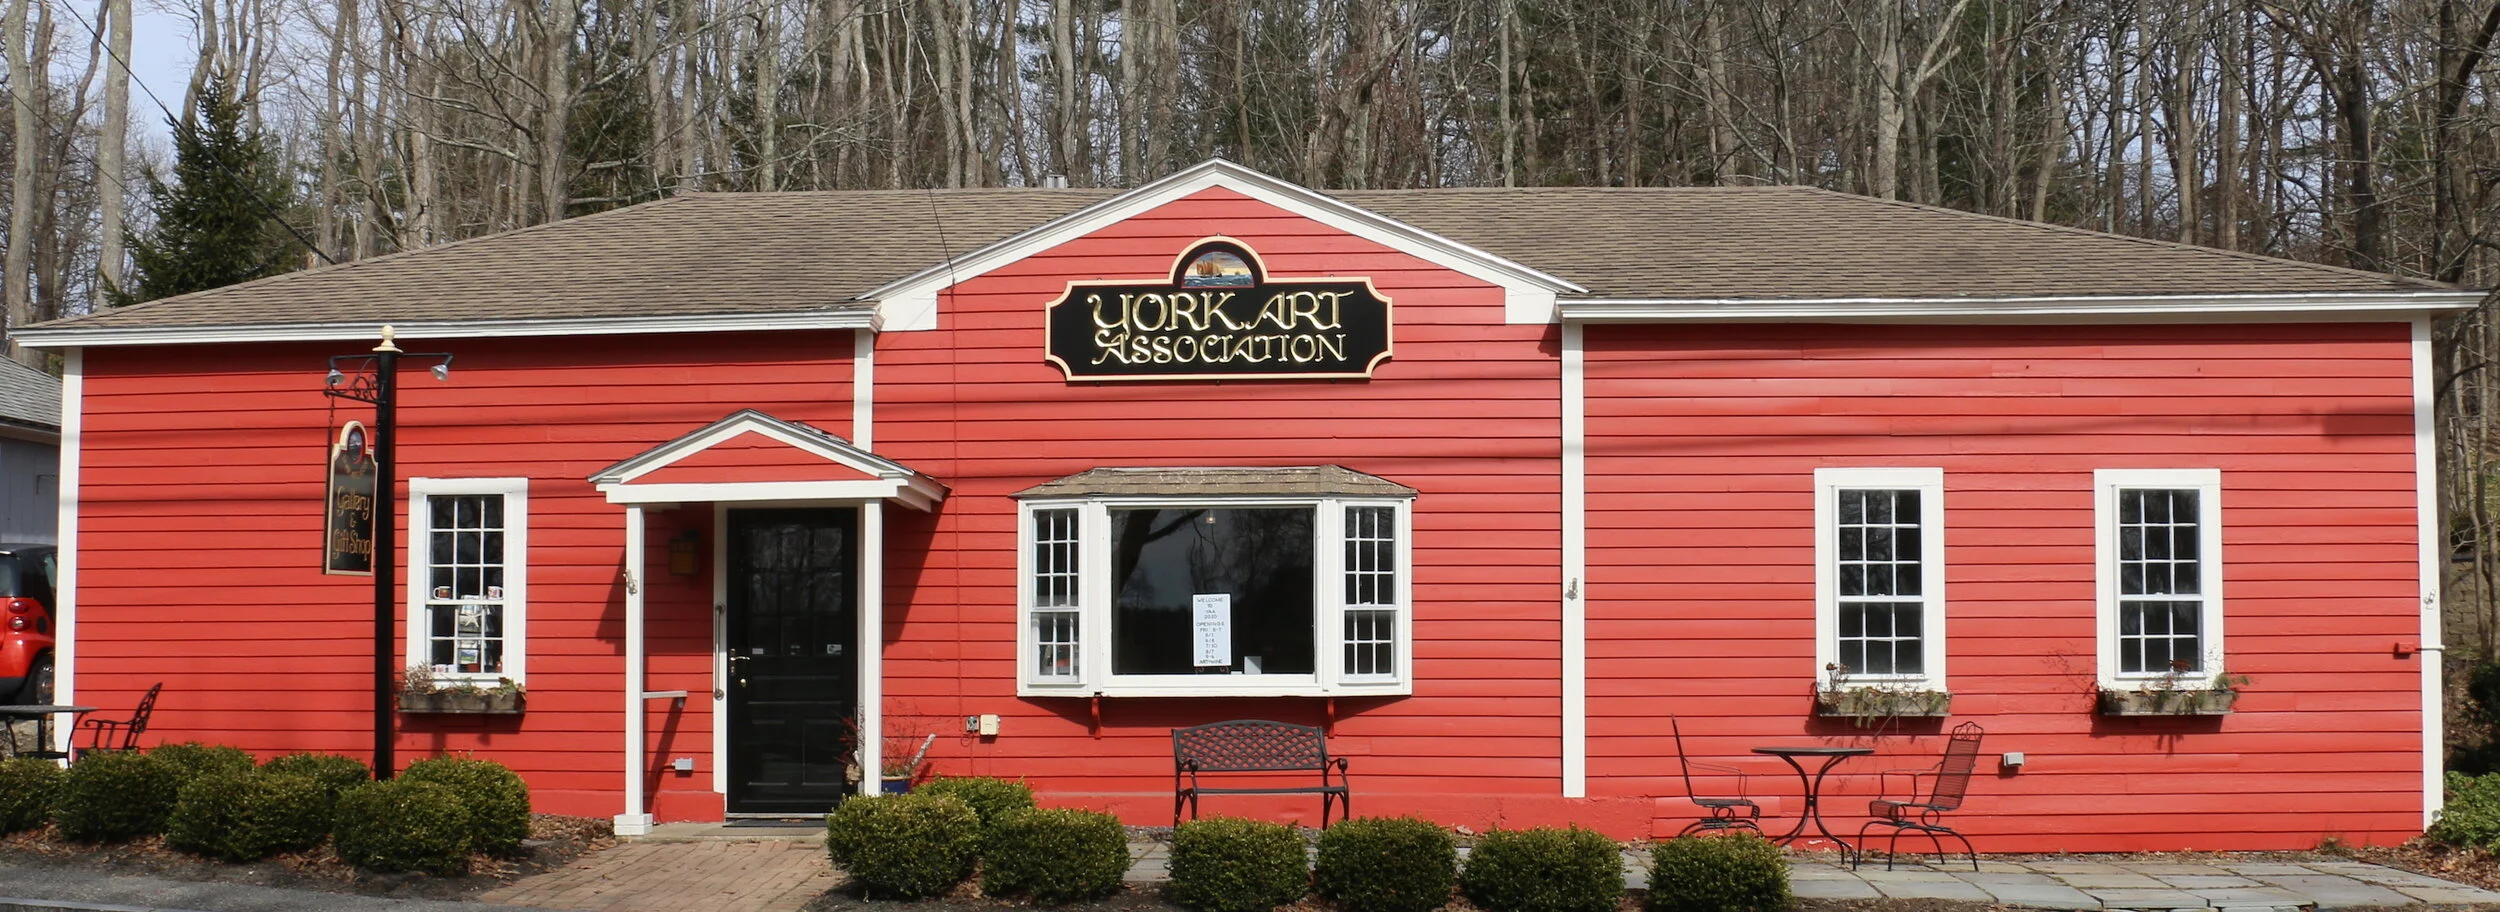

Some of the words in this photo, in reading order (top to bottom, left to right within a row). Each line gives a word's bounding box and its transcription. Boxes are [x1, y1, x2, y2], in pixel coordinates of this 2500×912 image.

[1087, 291, 1246, 338] YORK
[1245, 290, 1354, 330] ART
[1091, 330, 1348, 366] ASSOCIATION
[336, 486, 370, 520] Gallery
[332, 528, 350, 560] Gift
[350, 529, 371, 561] Shop
